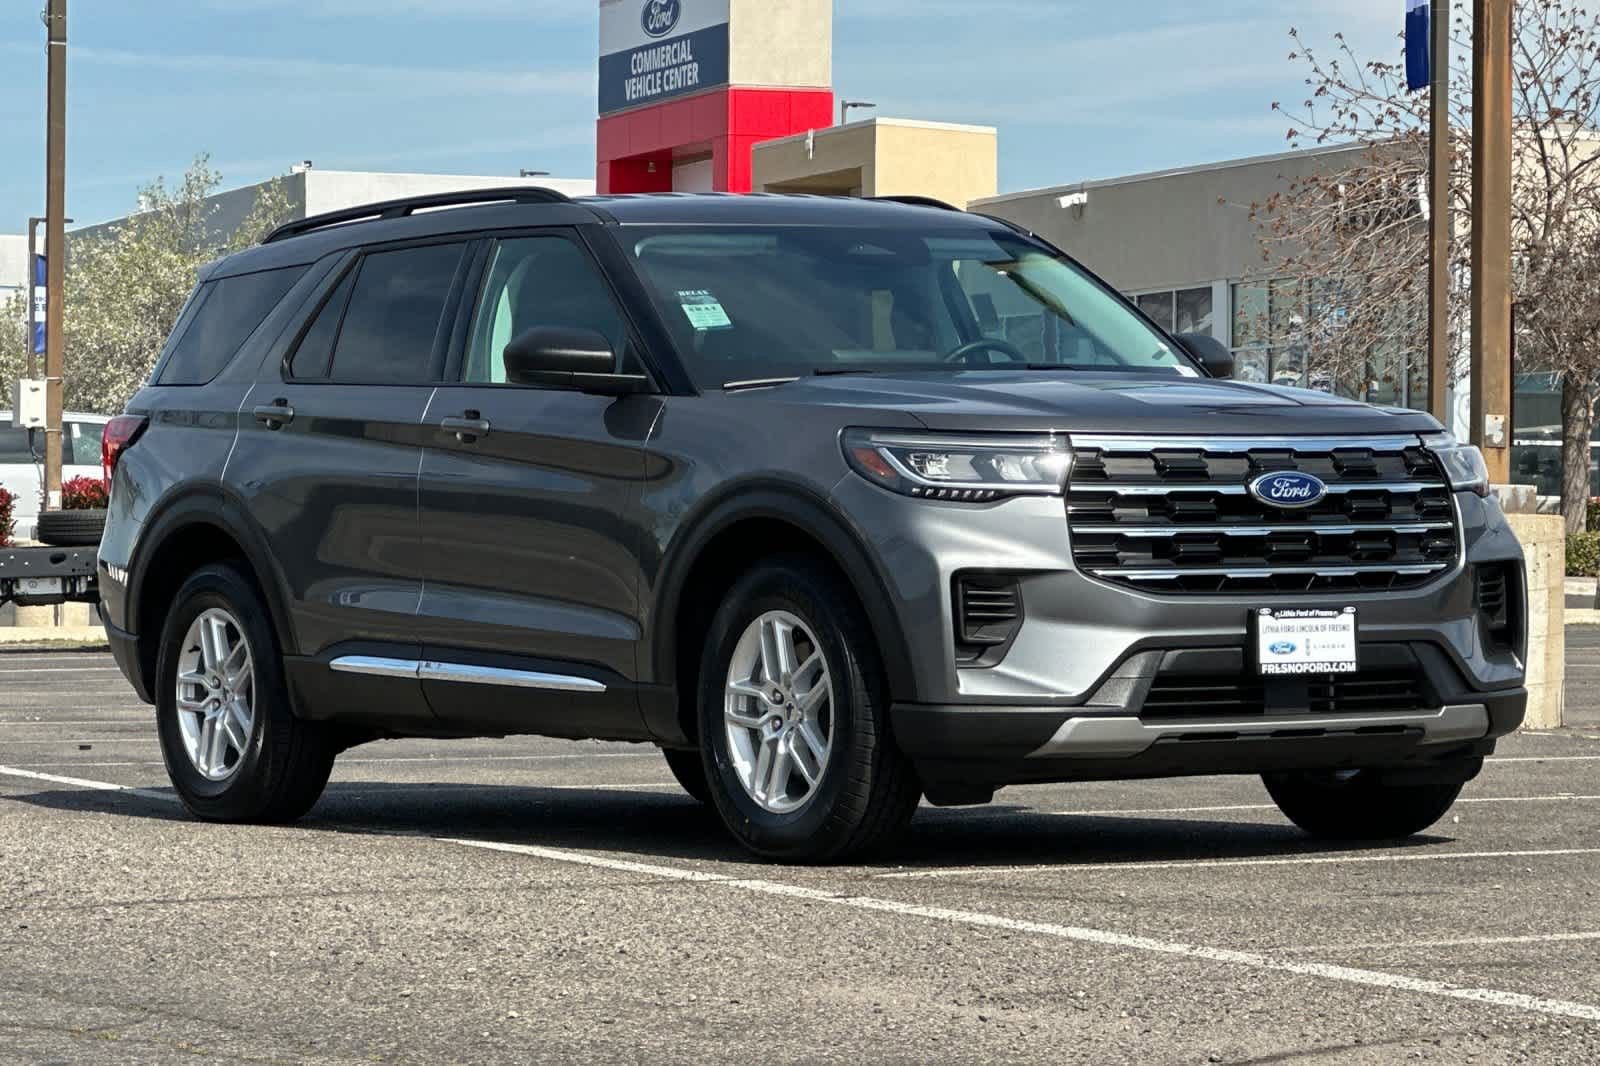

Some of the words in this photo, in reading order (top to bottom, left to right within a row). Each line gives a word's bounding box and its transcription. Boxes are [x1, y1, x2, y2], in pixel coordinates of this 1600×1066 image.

[648, 0, 674, 30] Ford
[631, 39, 693, 75] COMMERCIAL
[625, 71, 661, 101] VEHICLE
[663, 62, 699, 91] CENTER
[1271, 477, 1312, 498] Ford
[1280, 624, 1295, 633] FORD
[1296, 624, 1319, 632] LINCOLN
[1320, 624, 1327, 632] OF
[1328, 624, 1351, 632] FRESNO
[1261, 662, 1356, 674] FRESNOFORD.COM
